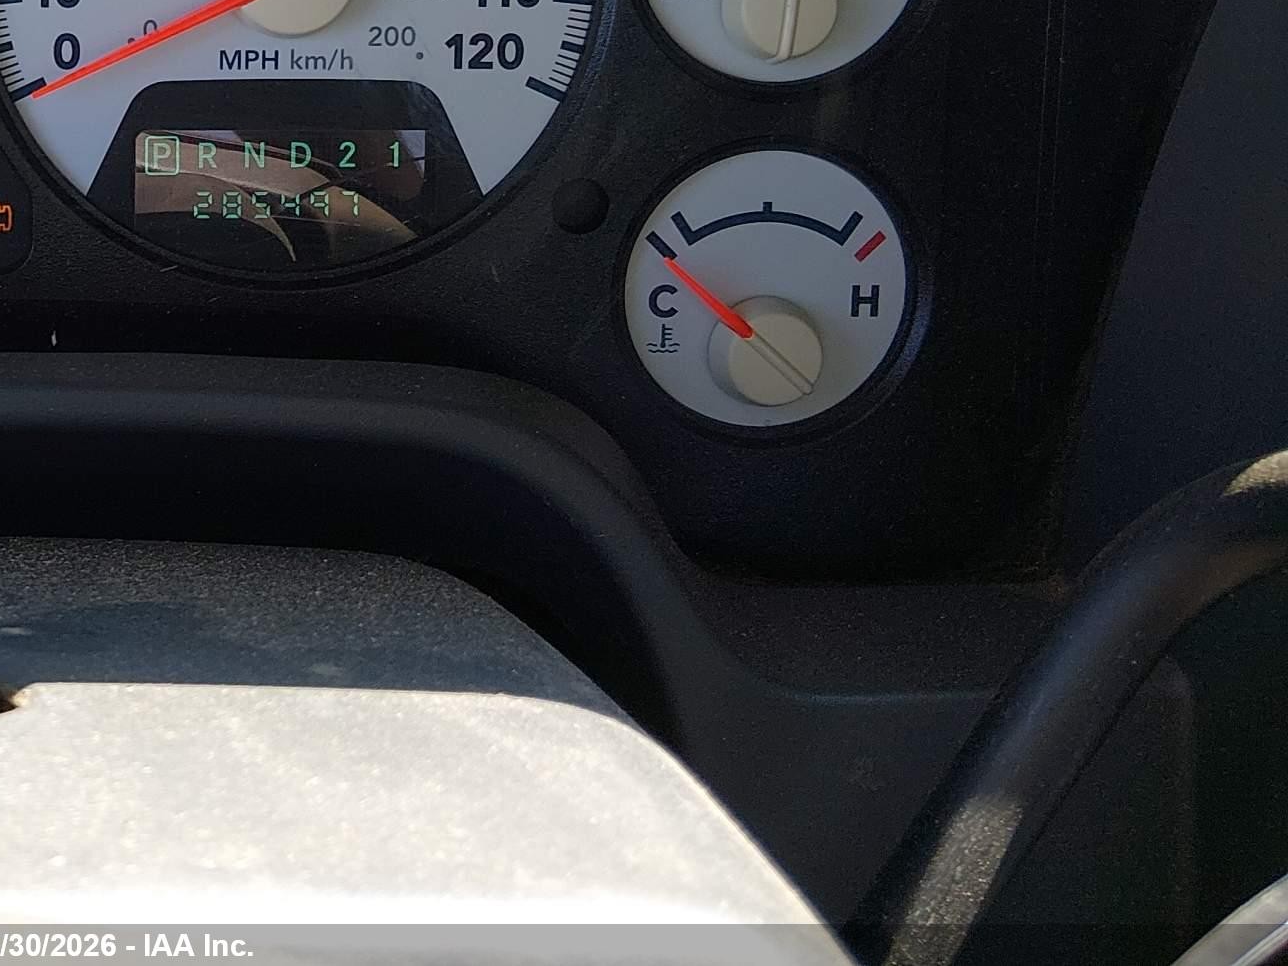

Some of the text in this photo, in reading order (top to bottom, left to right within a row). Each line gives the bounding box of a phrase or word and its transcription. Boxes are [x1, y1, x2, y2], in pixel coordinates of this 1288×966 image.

[369, 26, 415, 46] 200
[445, 33, 524, 69] 120
[54, 33, 80, 70] 0
[220, 49, 352, 70] MPH km/h
[152, 142, 401, 169] P R N D 2 1
[193, 191, 359, 219] 285497
[649, 285, 678, 318] C
[851, 285, 879, 317] H
